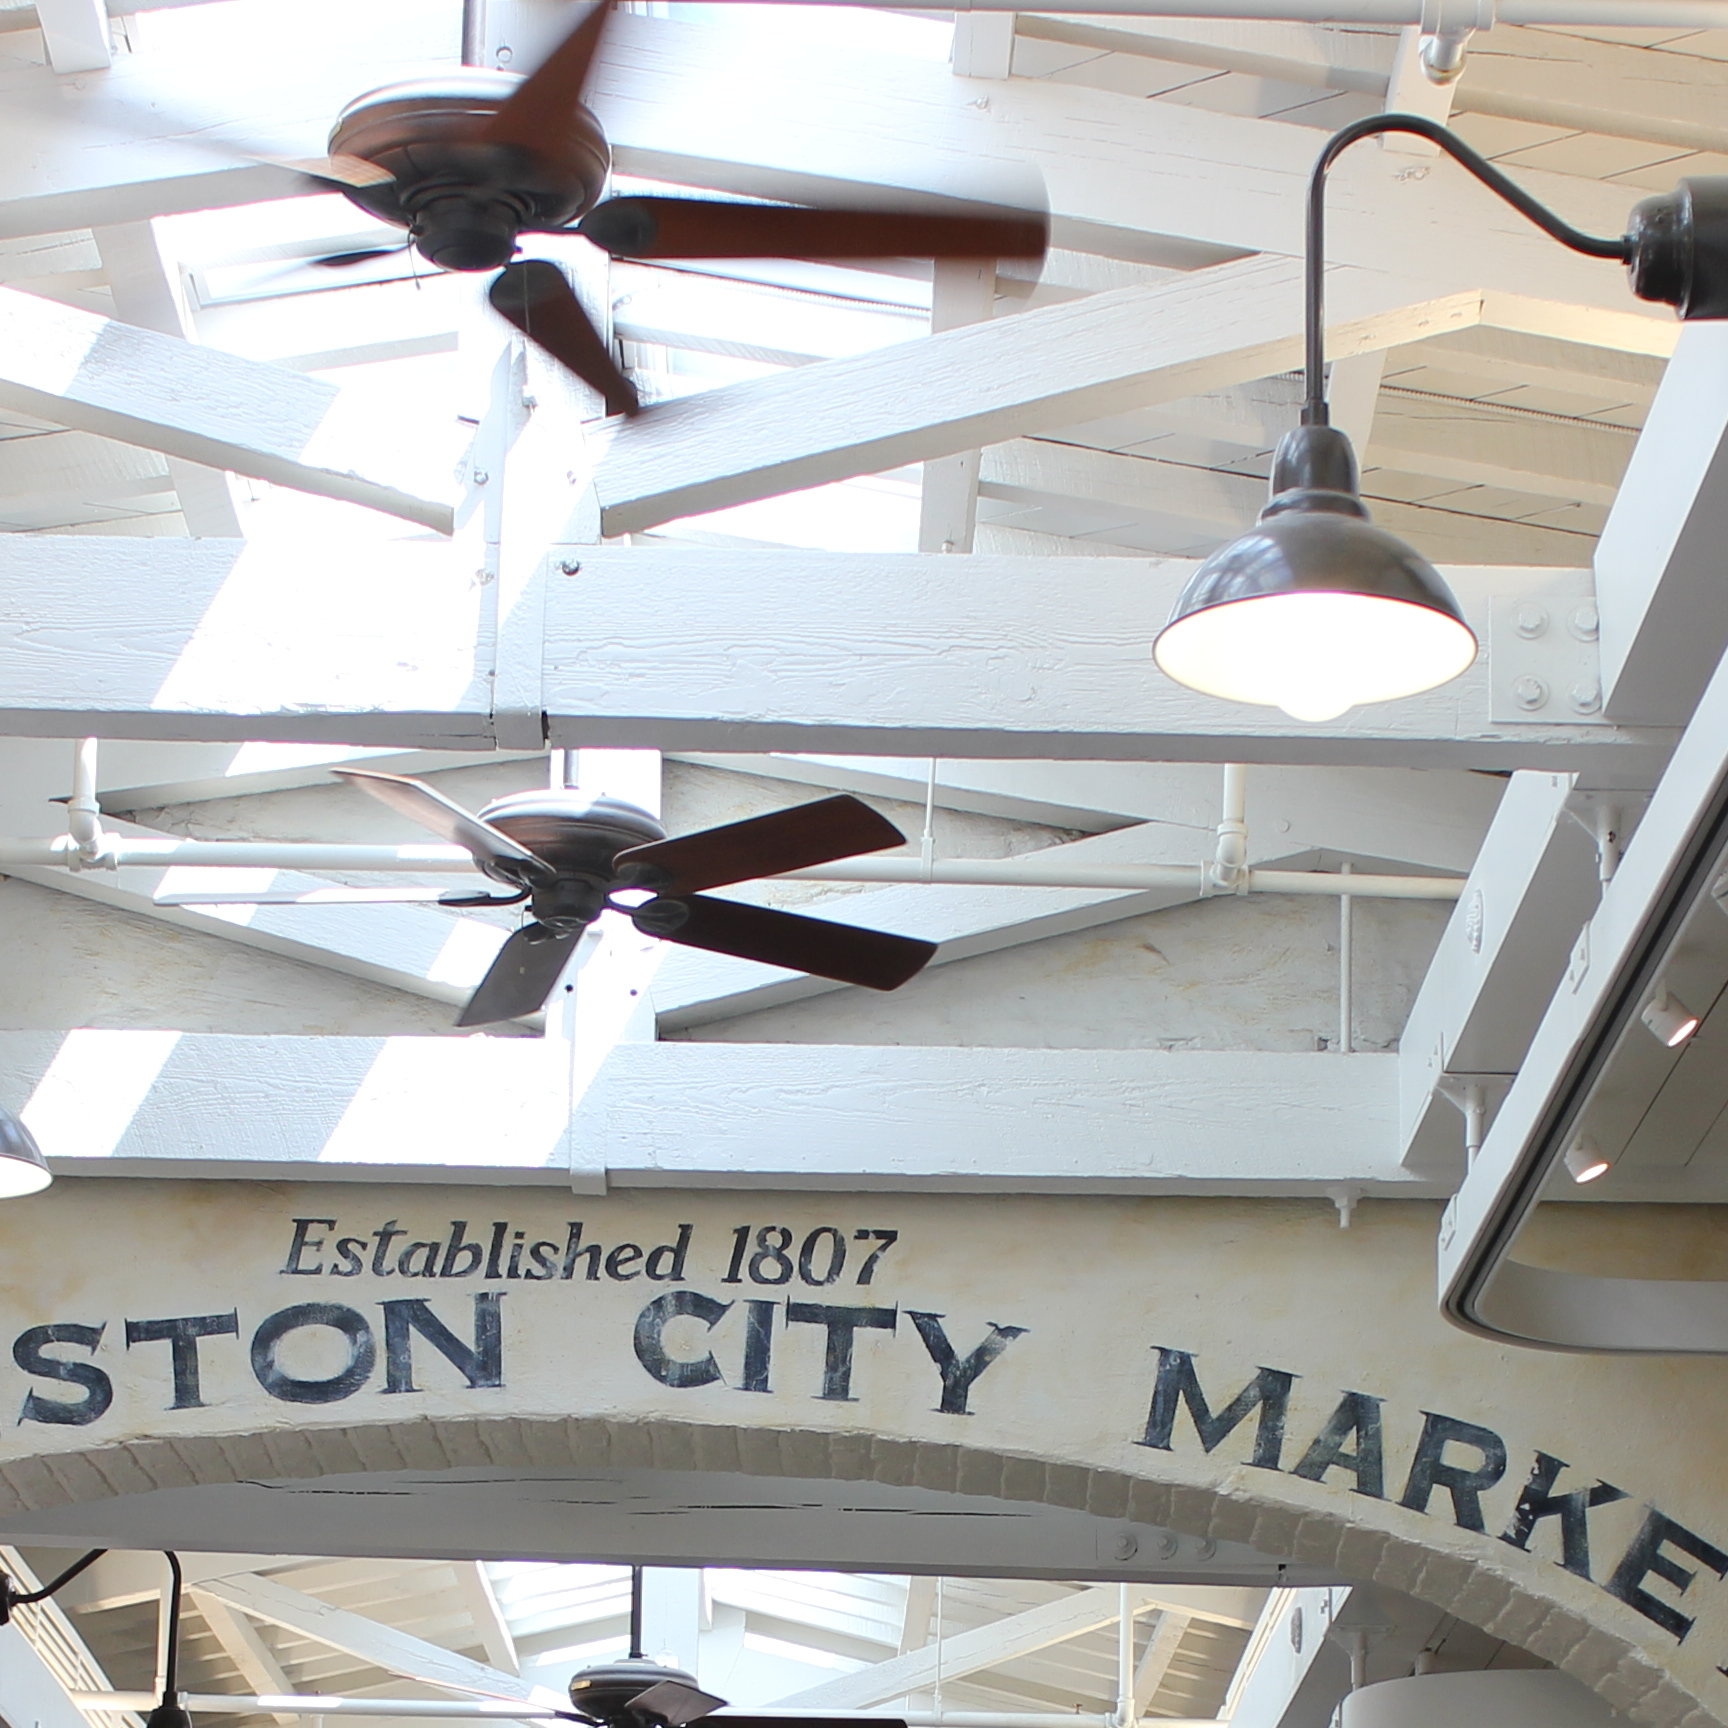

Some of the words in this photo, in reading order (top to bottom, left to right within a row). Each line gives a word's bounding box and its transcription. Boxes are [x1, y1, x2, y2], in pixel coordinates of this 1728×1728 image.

[278, 1217, 689, 1284] Established
[725, 1223, 900, 1288] 1807
[633, 1289, 1031, 1417] CITY
